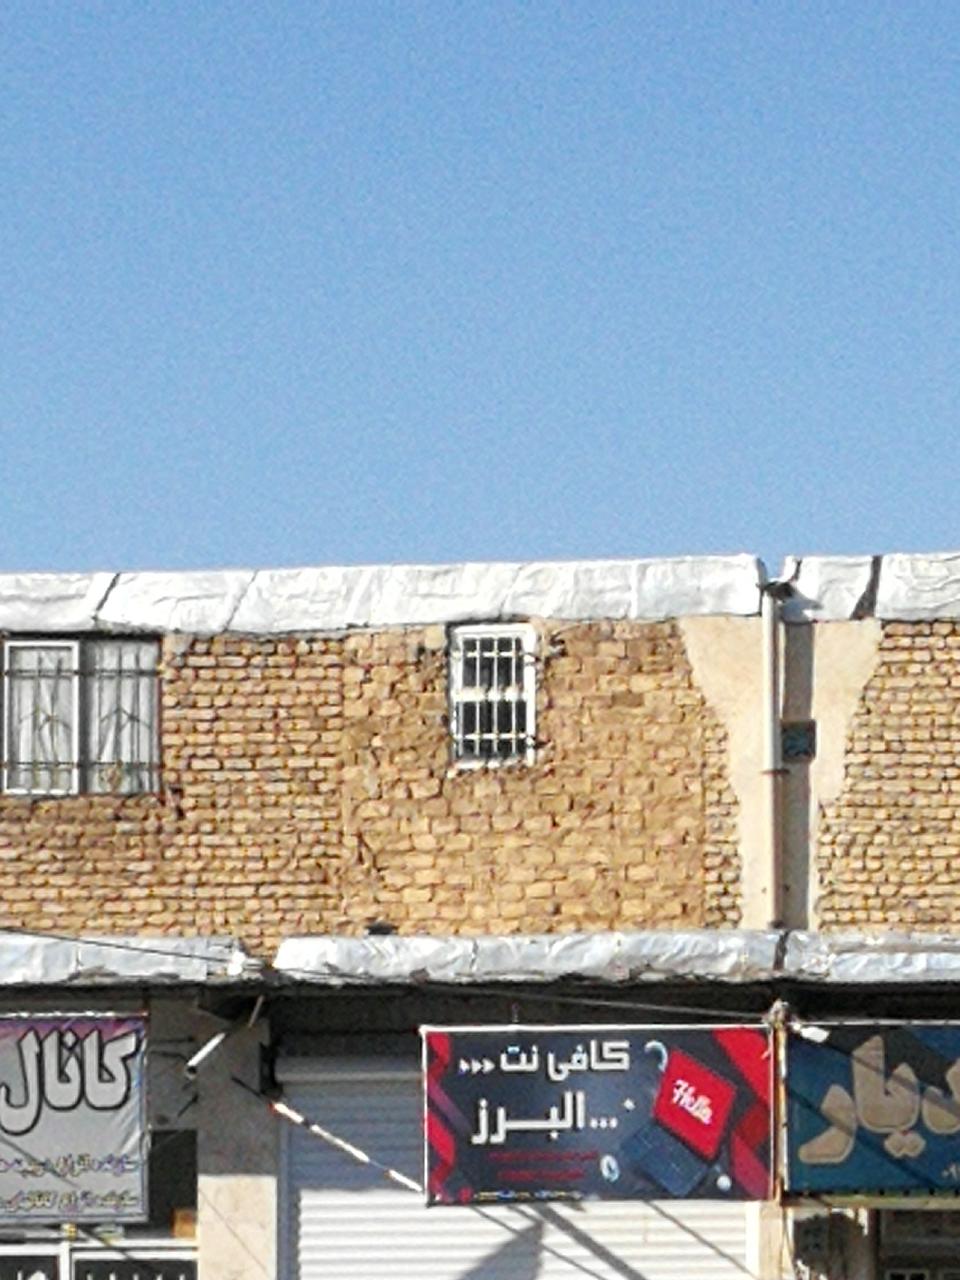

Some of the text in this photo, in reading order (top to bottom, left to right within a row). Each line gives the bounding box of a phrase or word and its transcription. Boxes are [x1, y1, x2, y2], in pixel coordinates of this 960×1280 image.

[0, 1027, 138, 1136] کانال
[500, 1040, 630, 1082] کافی نت
